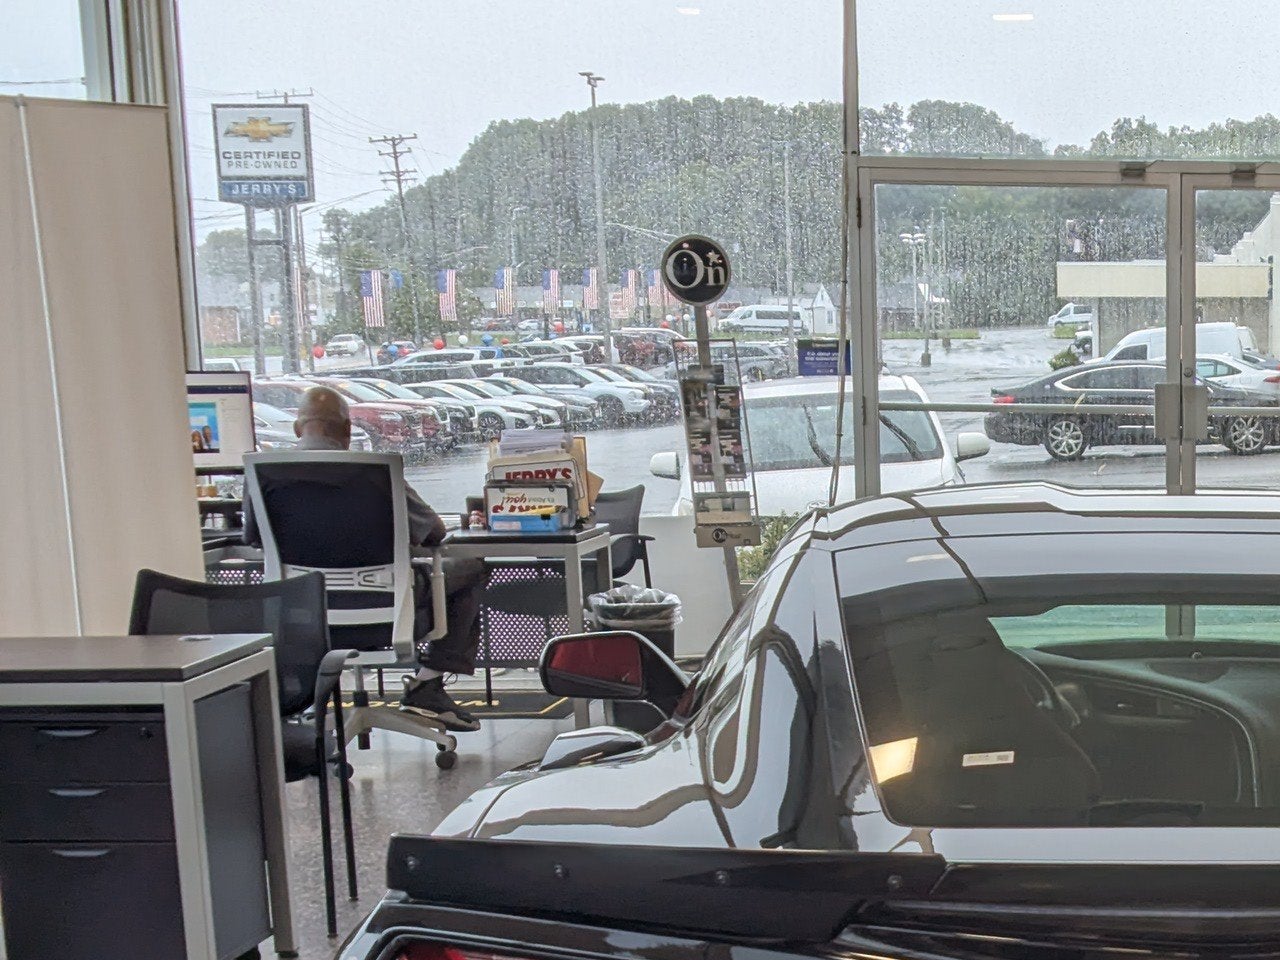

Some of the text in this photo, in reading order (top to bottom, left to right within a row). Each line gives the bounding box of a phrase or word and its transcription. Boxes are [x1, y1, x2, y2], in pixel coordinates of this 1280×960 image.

[222, 151, 302, 160] CERTIFIED
[227, 160, 299, 169] PRE-OWNED
[231, 184, 297, 195] JERRY'S
[666, 249, 726, 289] On
